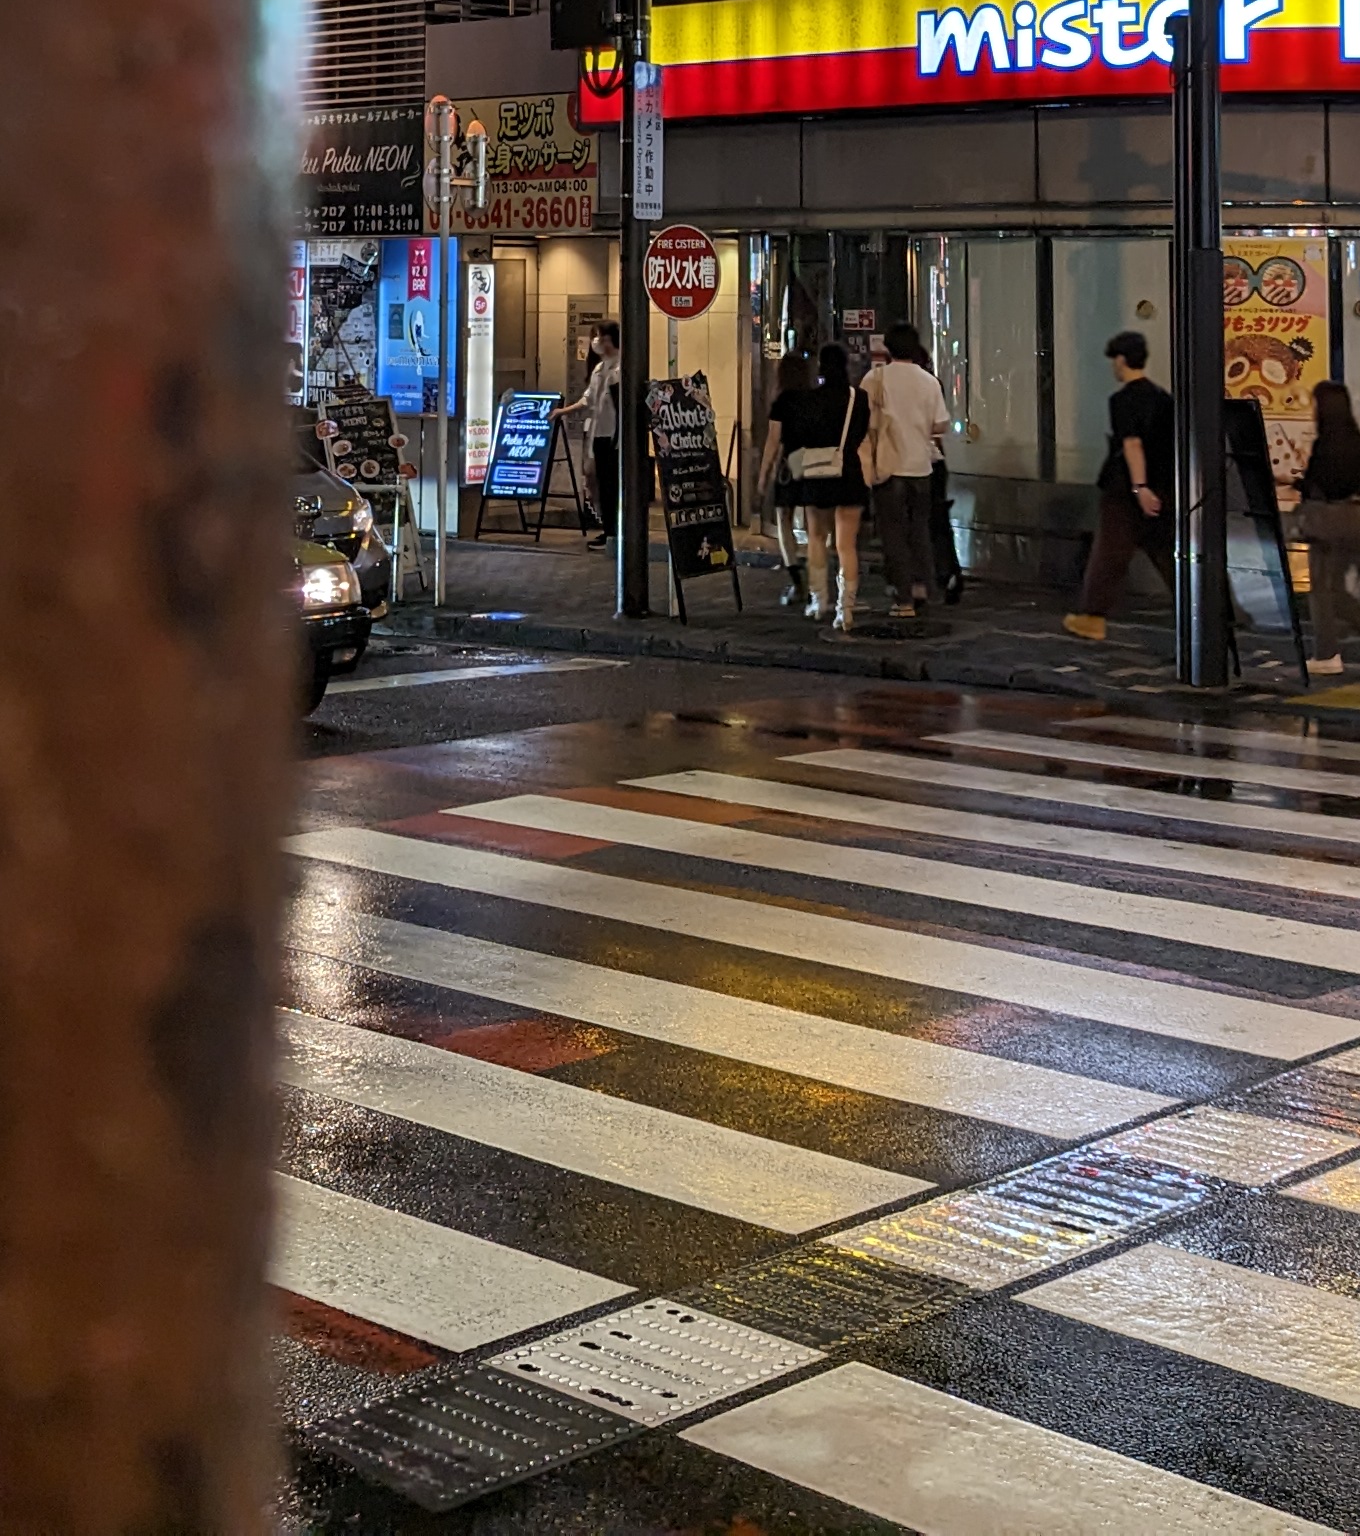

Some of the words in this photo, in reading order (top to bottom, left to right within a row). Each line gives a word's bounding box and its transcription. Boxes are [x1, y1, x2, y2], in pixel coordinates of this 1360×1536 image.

[498, 97, 555, 142] 足ツボ
[645, 86, 654, 196] 犯カメラ作動中
[322, 145, 363, 174] Puku
[364, 144, 414, 172] NEON
[657, 239, 673, 249] FIRE
[675, 239, 706, 249] CISTERN
[648, 255, 716, 290] 防火水槽
